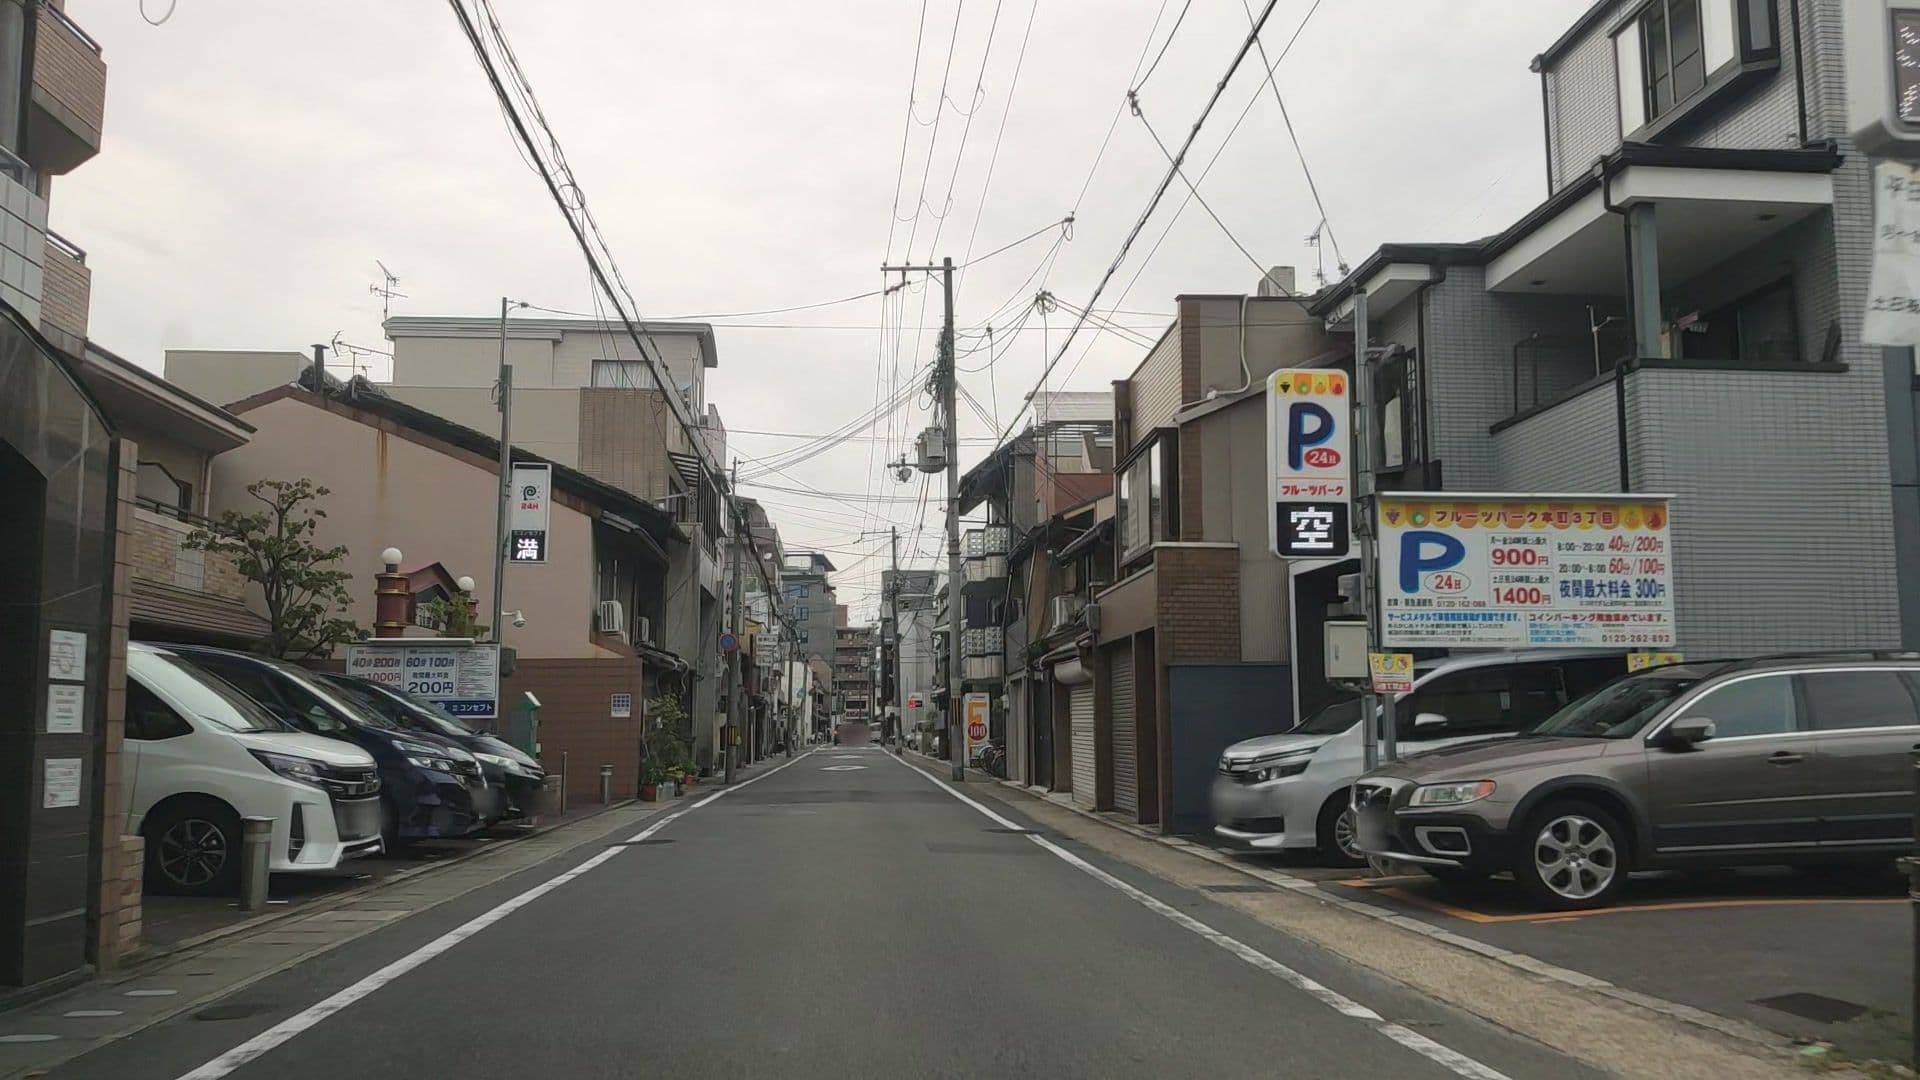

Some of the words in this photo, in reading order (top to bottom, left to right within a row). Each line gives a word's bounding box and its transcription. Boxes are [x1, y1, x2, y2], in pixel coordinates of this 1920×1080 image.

[1288, 402, 1336, 472] P
[1281, 484, 1344, 497] フルーツパーク
[1290, 505, 1334, 549] 空
[516, 538, 540, 560] 満
[1491, 548, 1549, 566] 900円
[1400, 530, 1466, 594] P
[1493, 587, 1552, 605] 1400円
[1559, 579, 1632, 599] 夜間最大料金
[1635, 578, 1666, 598] 300円
[408, 681, 454, 694] 200円
[970, 725, 986, 737] 100
